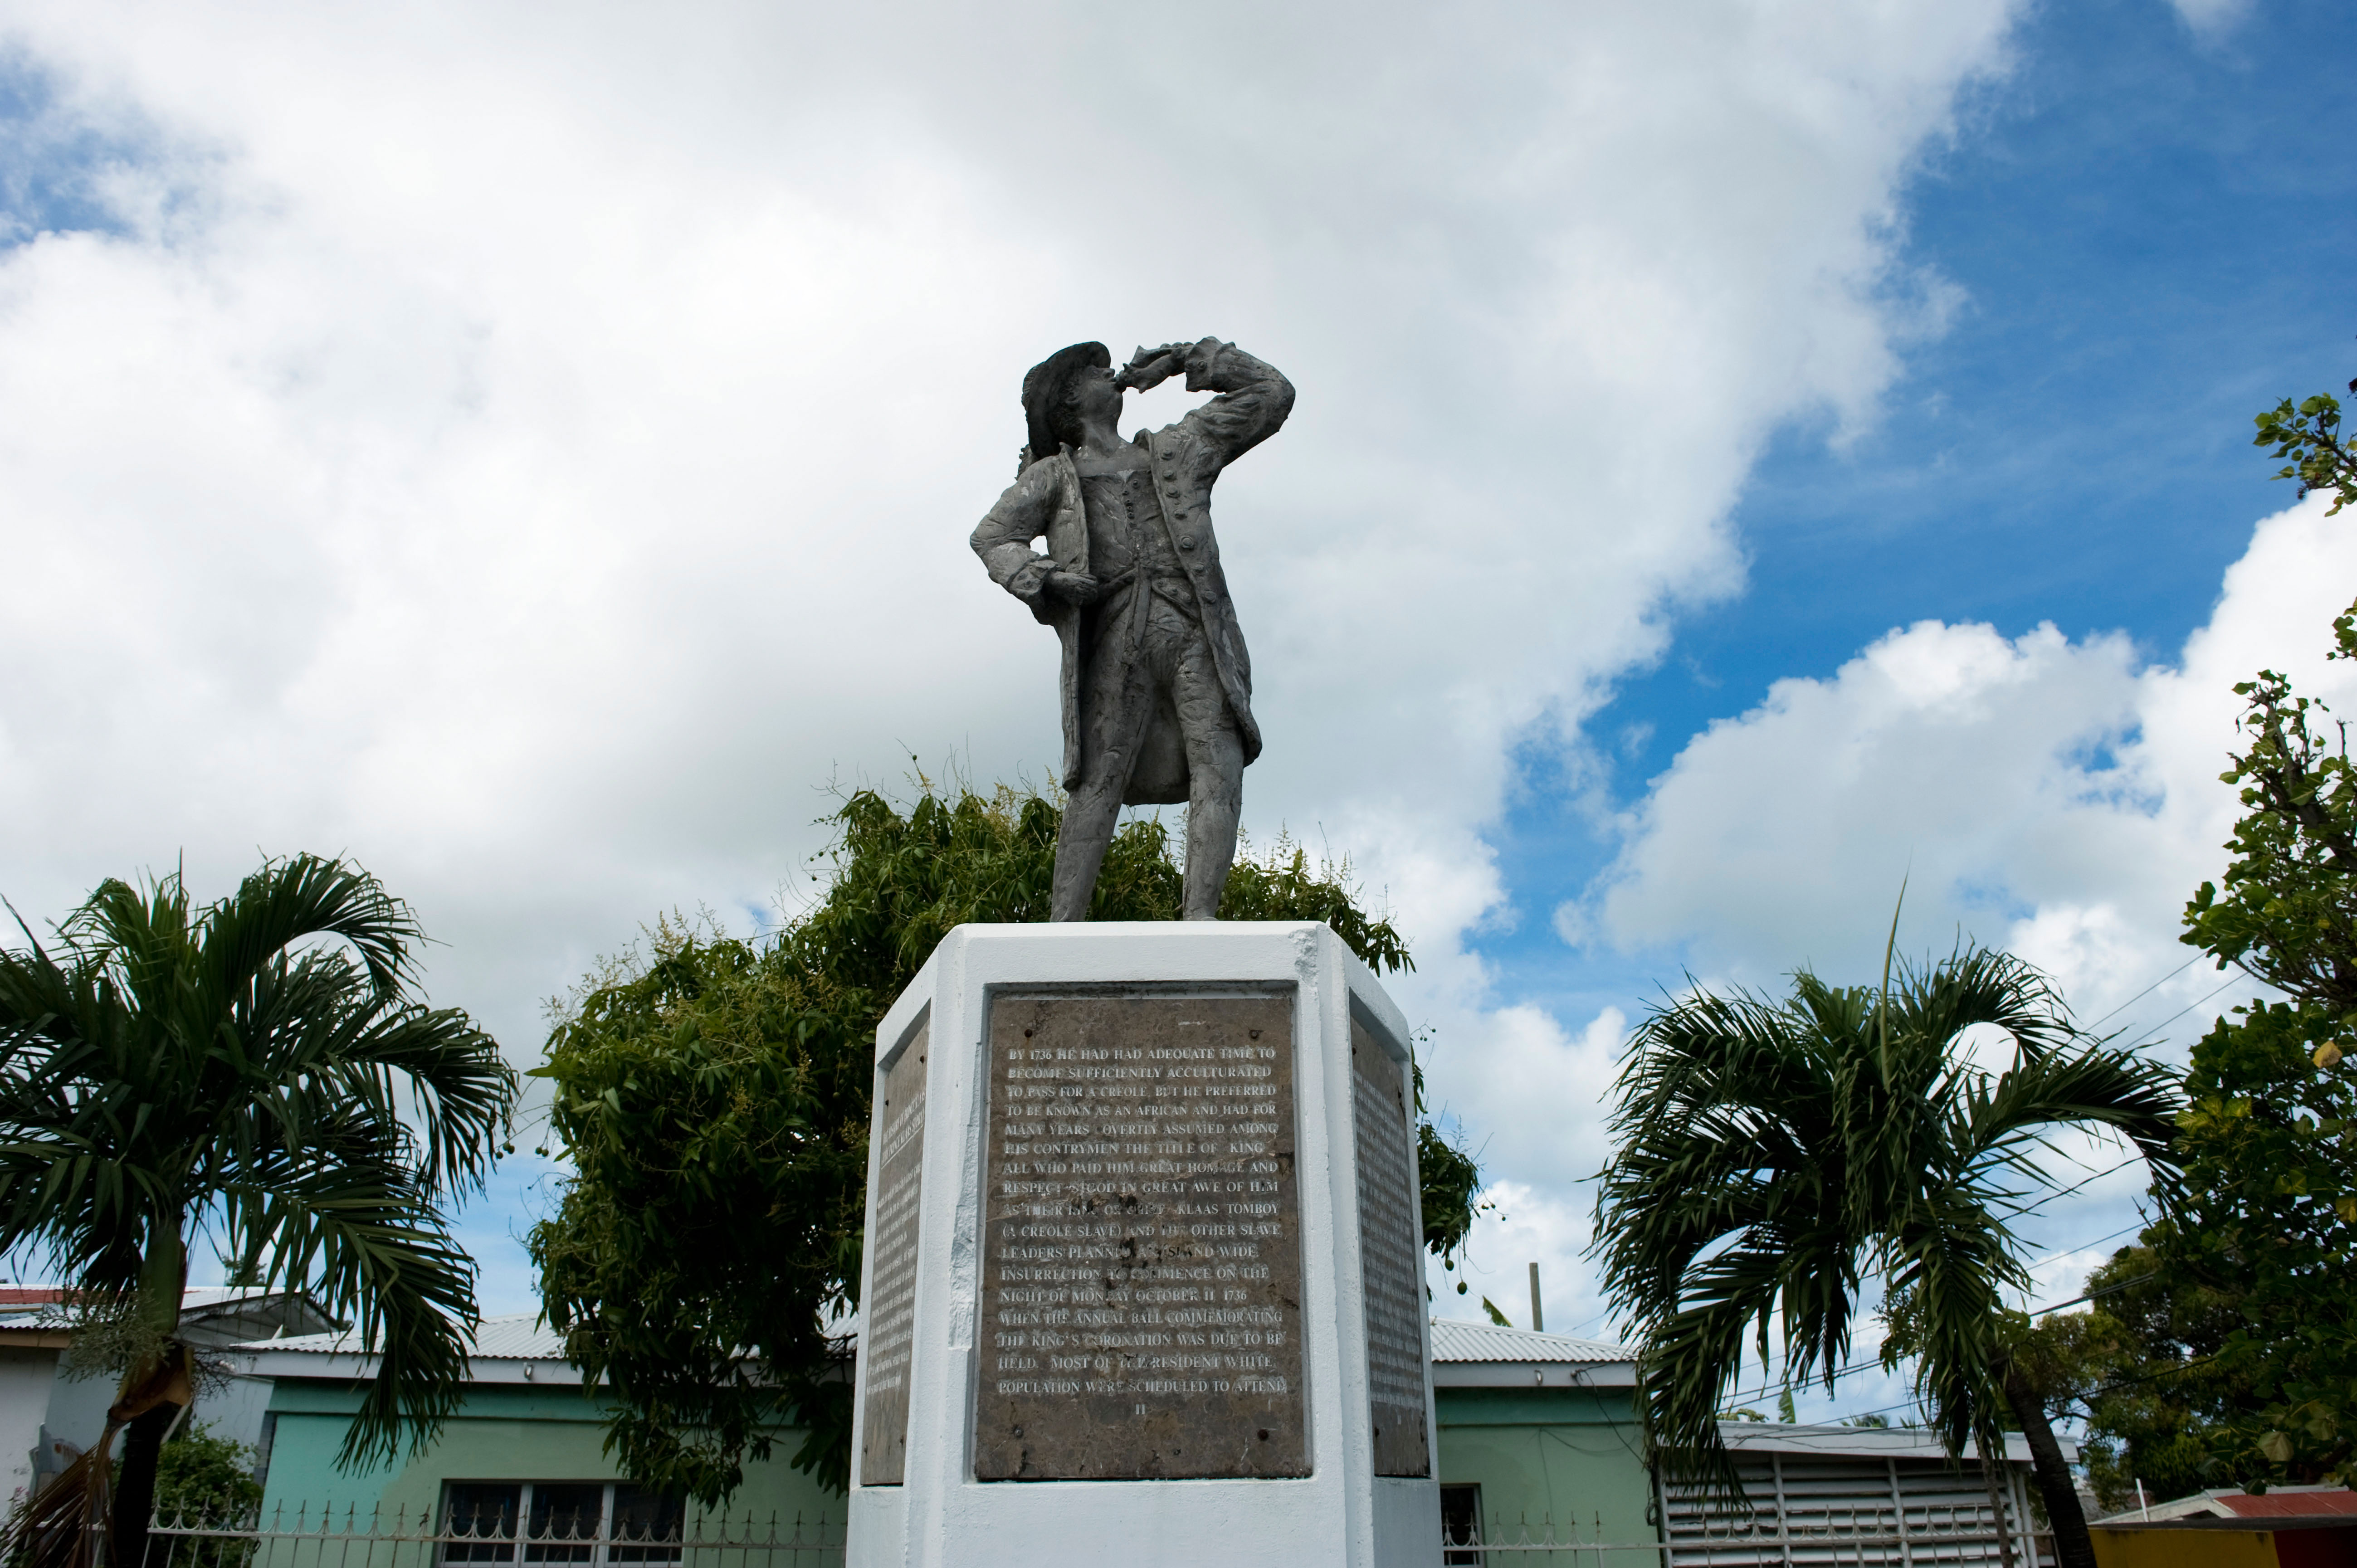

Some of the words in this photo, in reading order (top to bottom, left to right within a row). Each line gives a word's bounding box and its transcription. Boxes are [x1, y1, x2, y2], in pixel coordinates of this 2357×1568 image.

[1009, 1049, 1025, 1060] BY
[1030, 1049, 1052, 1060] 1736
[1057, 1049, 1077, 1060] HE
[1081, 1049, 1109, 1060] HAD
[1114, 1048, 1142, 1060] HAD
[1147, 1048, 1215, 1061] ADEQUATE
[1219, 1048, 1253, 1059] TIME
[1257, 1048, 1276, 1059] TO
[1007, 1068, 1064, 1079] BECOME
[1068, 1067, 1161, 1078] SUFFICIENTLY
[1167, 1066, 1272, 1078] ACCULTURATED
[1005, 1087, 1023, 1097] TO
[1027, 1086, 1055, 1097] PASS
[1060, 1086, 1083, 1097] FOR
[1088, 1086, 1096, 1097] A
[1155, 1086, 1179, 1096] BUT
[1183, 1086, 1201, 1096] HE
[1205, 1086, 1277, 1096] PREFERRED
[1005, 1105, 1022, 1116] TO
[1026, 1105, 1042, 1116] BE
[1046, 1105, 1090, 1116] KNOWN
[1095, 1105, 1110, 1116] AS
[1114, 1105, 1131, 1115] AN
[1136, 1105, 1187, 1115] AFRICAN
[1192, 1105, 1218, 1115] AND
[1222, 1105, 1248, 1115] HAD
[1253, 1105, 1277, 1115] FOR
[1004, 1125, 1044, 1135] MANY
[1102, 1124, 1157, 1135] OVERTLY
[1163, 1124, 1225, 1135] ASSUMED
[1229, 1123, 1279, 1135] AMONG
[1004, 1143, 1029, 1154] HIS
[1033, 1143, 1118, 1154] CONTRYMEN
[1123, 1142, 1151, 1154] THE
[1156, 1142, 1196, 1154] TITLE
[1200, 1142, 1218, 1154] OF
[1003, 1163, 1030, 1174] ALL
[1033, 1162, 1067, 1174] WHO
[1071, 1162, 1102, 1173] PAID
[1107, 1162, 1134, 1173] HIM
[1139, 1162, 1182, 1173] GREAT
[1188, 1161, 1244, 1173] HOMAGE
[1249, 1161, 1278, 1173] AND
[1120, 1182, 1137, 1193] IN
[1142, 1181, 1186, 1193] GREAT
[1192, 1181, 1221, 1193] AWE
[1226, 1181, 1245, 1193] OF
[1025, 1204, 1063, 1216] THEIR
[1177, 1203, 1219, 1215] KLAAS
[1226, 1203, 1279, 1215] TOMBOY
[1020, 1225, 1072, 1237] CREOLE
[1077, 1225, 1122, 1237] SLAVE)
[1129, 1225, 1155, 1237] AND
[1161, 1225, 1186, 1237] THE
[1191, 1224, 1235, 1237] OTHER
[1001, 1247, 1063, 1259] LEADERS
[1000, 1268, 1102, 1281] INSURRECTION
[1131, 1268, 1211, 1280] COMMENCE
[1216, 1267, 1236, 1279] ON
[1242, 1267, 1269, 1279] THE
[1000, 1290, 1043, 1302] NIGHT
[1049, 1290, 1066, 1302] OF
[1135, 1290, 1198, 1301] OCTOBER
[1223, 1289, 1247, 1301] 1736
[999, 1312, 1039, 1324] WHEN
[1074, 1312, 1126, 1324] ANNUAL
[1131, 1311, 1163, 1324] BALL
[1166, 1311, 1283, 1323] COMMEMORATING
[1000, 1335, 1026, 1347] THE
[1084, 1334, 1171, 1346] CORONATION
[1177, 1334, 1205, 1345] WAS
[1210, 1334, 1237, 1345] DUE
[1244, 1333, 1261, 1345] TO
[1266, 1333, 1283, 1345] BE
[1051, 1357, 1090, 1368] MOST
[1094, 1356, 1112, 1368] OF
[1151, 1356, 1220, 1368] RESIDENT
[998, 1381, 1081, 1393] POPULATION
[1128, 1380, 1208, 1393] SCHEDULED
[1212, 1380, 1230, 1392] TO
[1234, 1380, 1286, 1392] ATTEND
